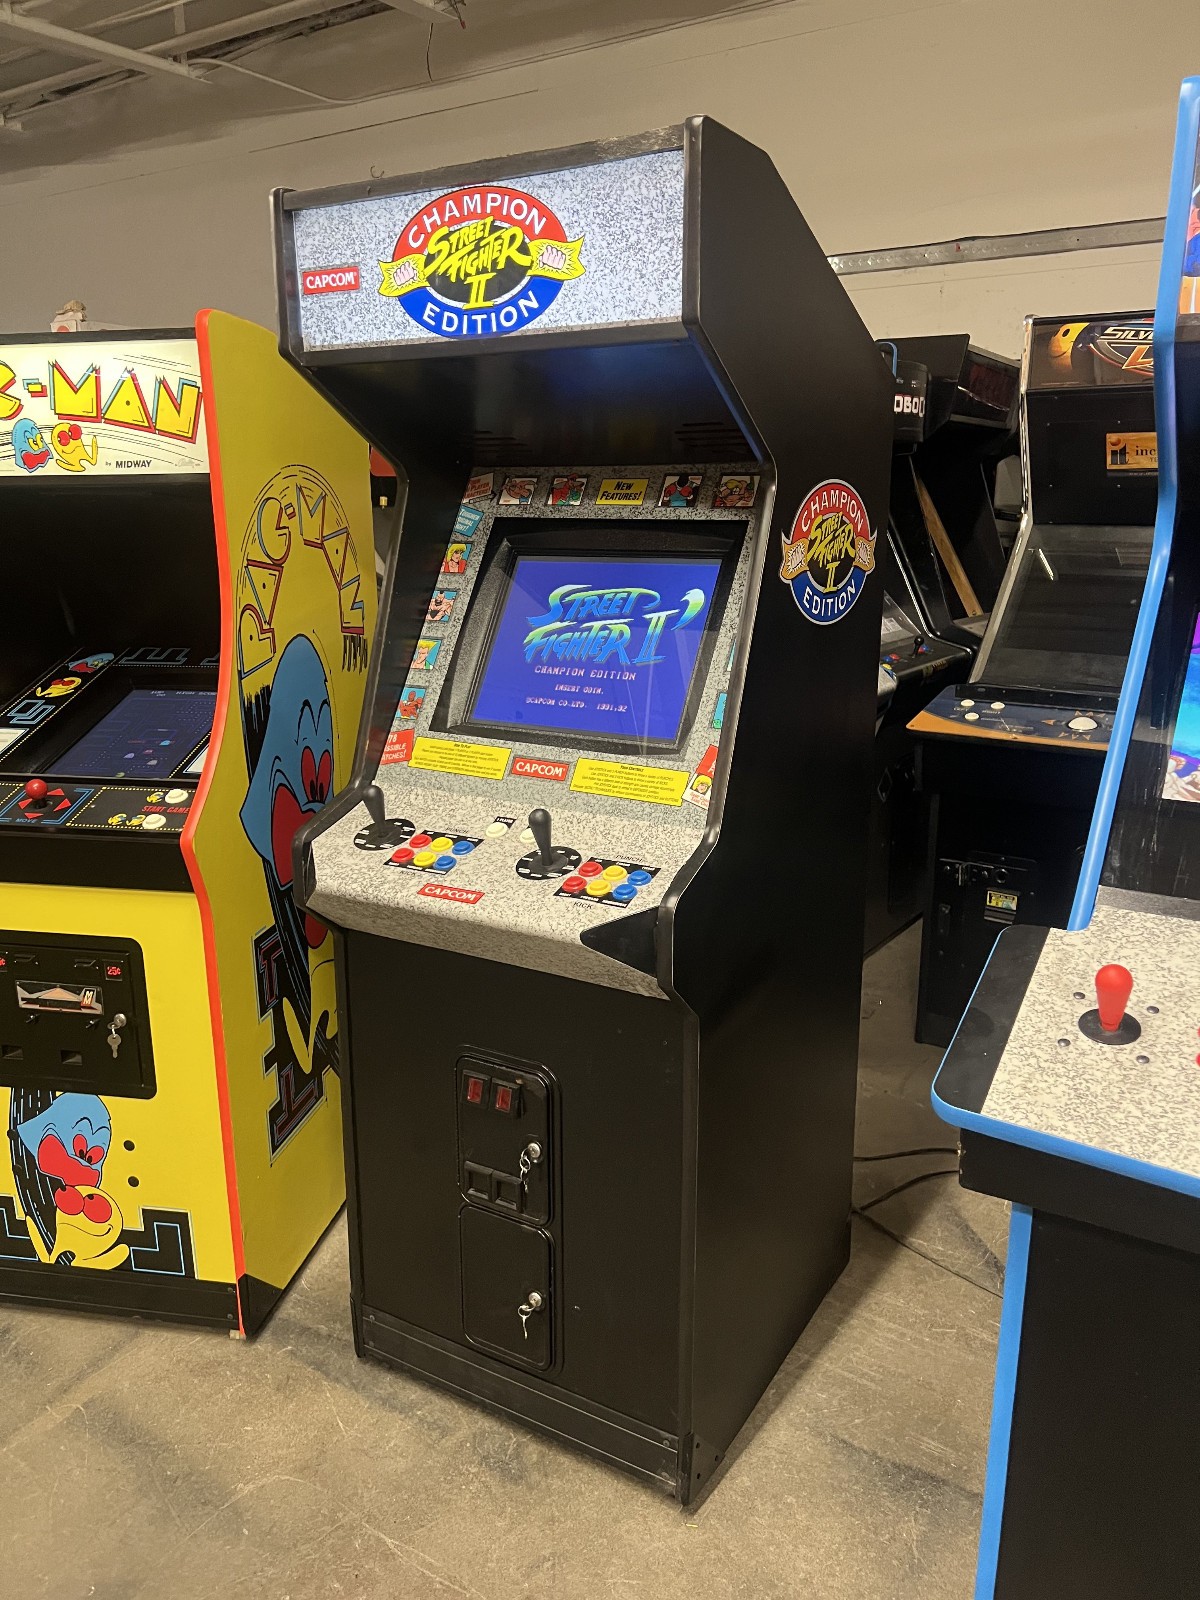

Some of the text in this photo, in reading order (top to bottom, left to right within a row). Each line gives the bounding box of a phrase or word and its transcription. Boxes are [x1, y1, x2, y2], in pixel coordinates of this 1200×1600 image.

[408, 193, 547, 249] CHAMPION
[424, 216, 494, 280] STREET
[440, 227, 532, 283] FIGHTER
[306, 271, 357, 289] CAPCOM
[461, 273, 496, 310] II
[423, 291, 539, 334] EDITION
[115, 460, 152, 468] MIDWAY
[600, 491, 642, 500] FEATURES!
[614, 481, 634, 490] NEW
[802, 490, 864, 532] CHAMPION
[806, 512, 843, 562] STREET
[813, 523, 856, 568] FIGHTER
[237, 483, 365, 680] PAC-MAN
[823, 561, 841, 592] II
[526, 584, 660, 628] STREET
[803, 579, 856, 616] EDITION
[523, 618, 634, 664] FIGHTER
[534, 665, 636, 681] CHAMPION EDITION
[554, 683, 581, 693] INSERT
[515, 761, 566, 777] CAPCOM
[424, 886, 477, 901] CAPCOM
[573, 901, 593, 909] KICK
